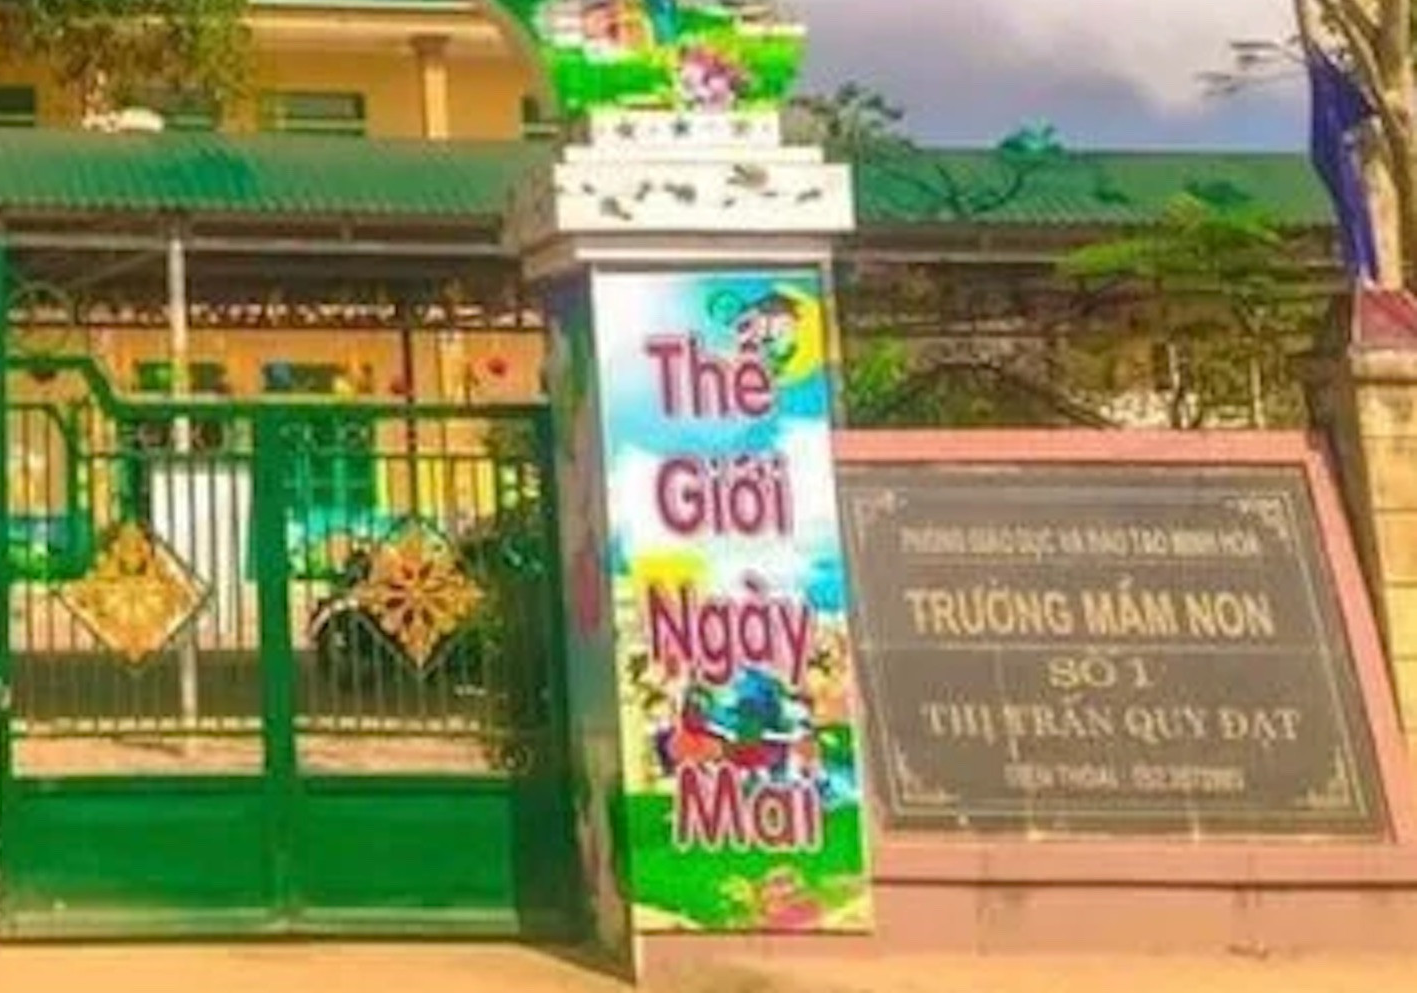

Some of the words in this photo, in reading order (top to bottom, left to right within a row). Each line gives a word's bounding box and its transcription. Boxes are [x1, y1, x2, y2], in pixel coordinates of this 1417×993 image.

[655, 452, 793, 536] Giới
[647, 572, 810, 686] Ngày
[1183, 590, 1275, 638] NON
[1128, 656, 1156, 689] 1
[679, 763, 816, 846] Mai
